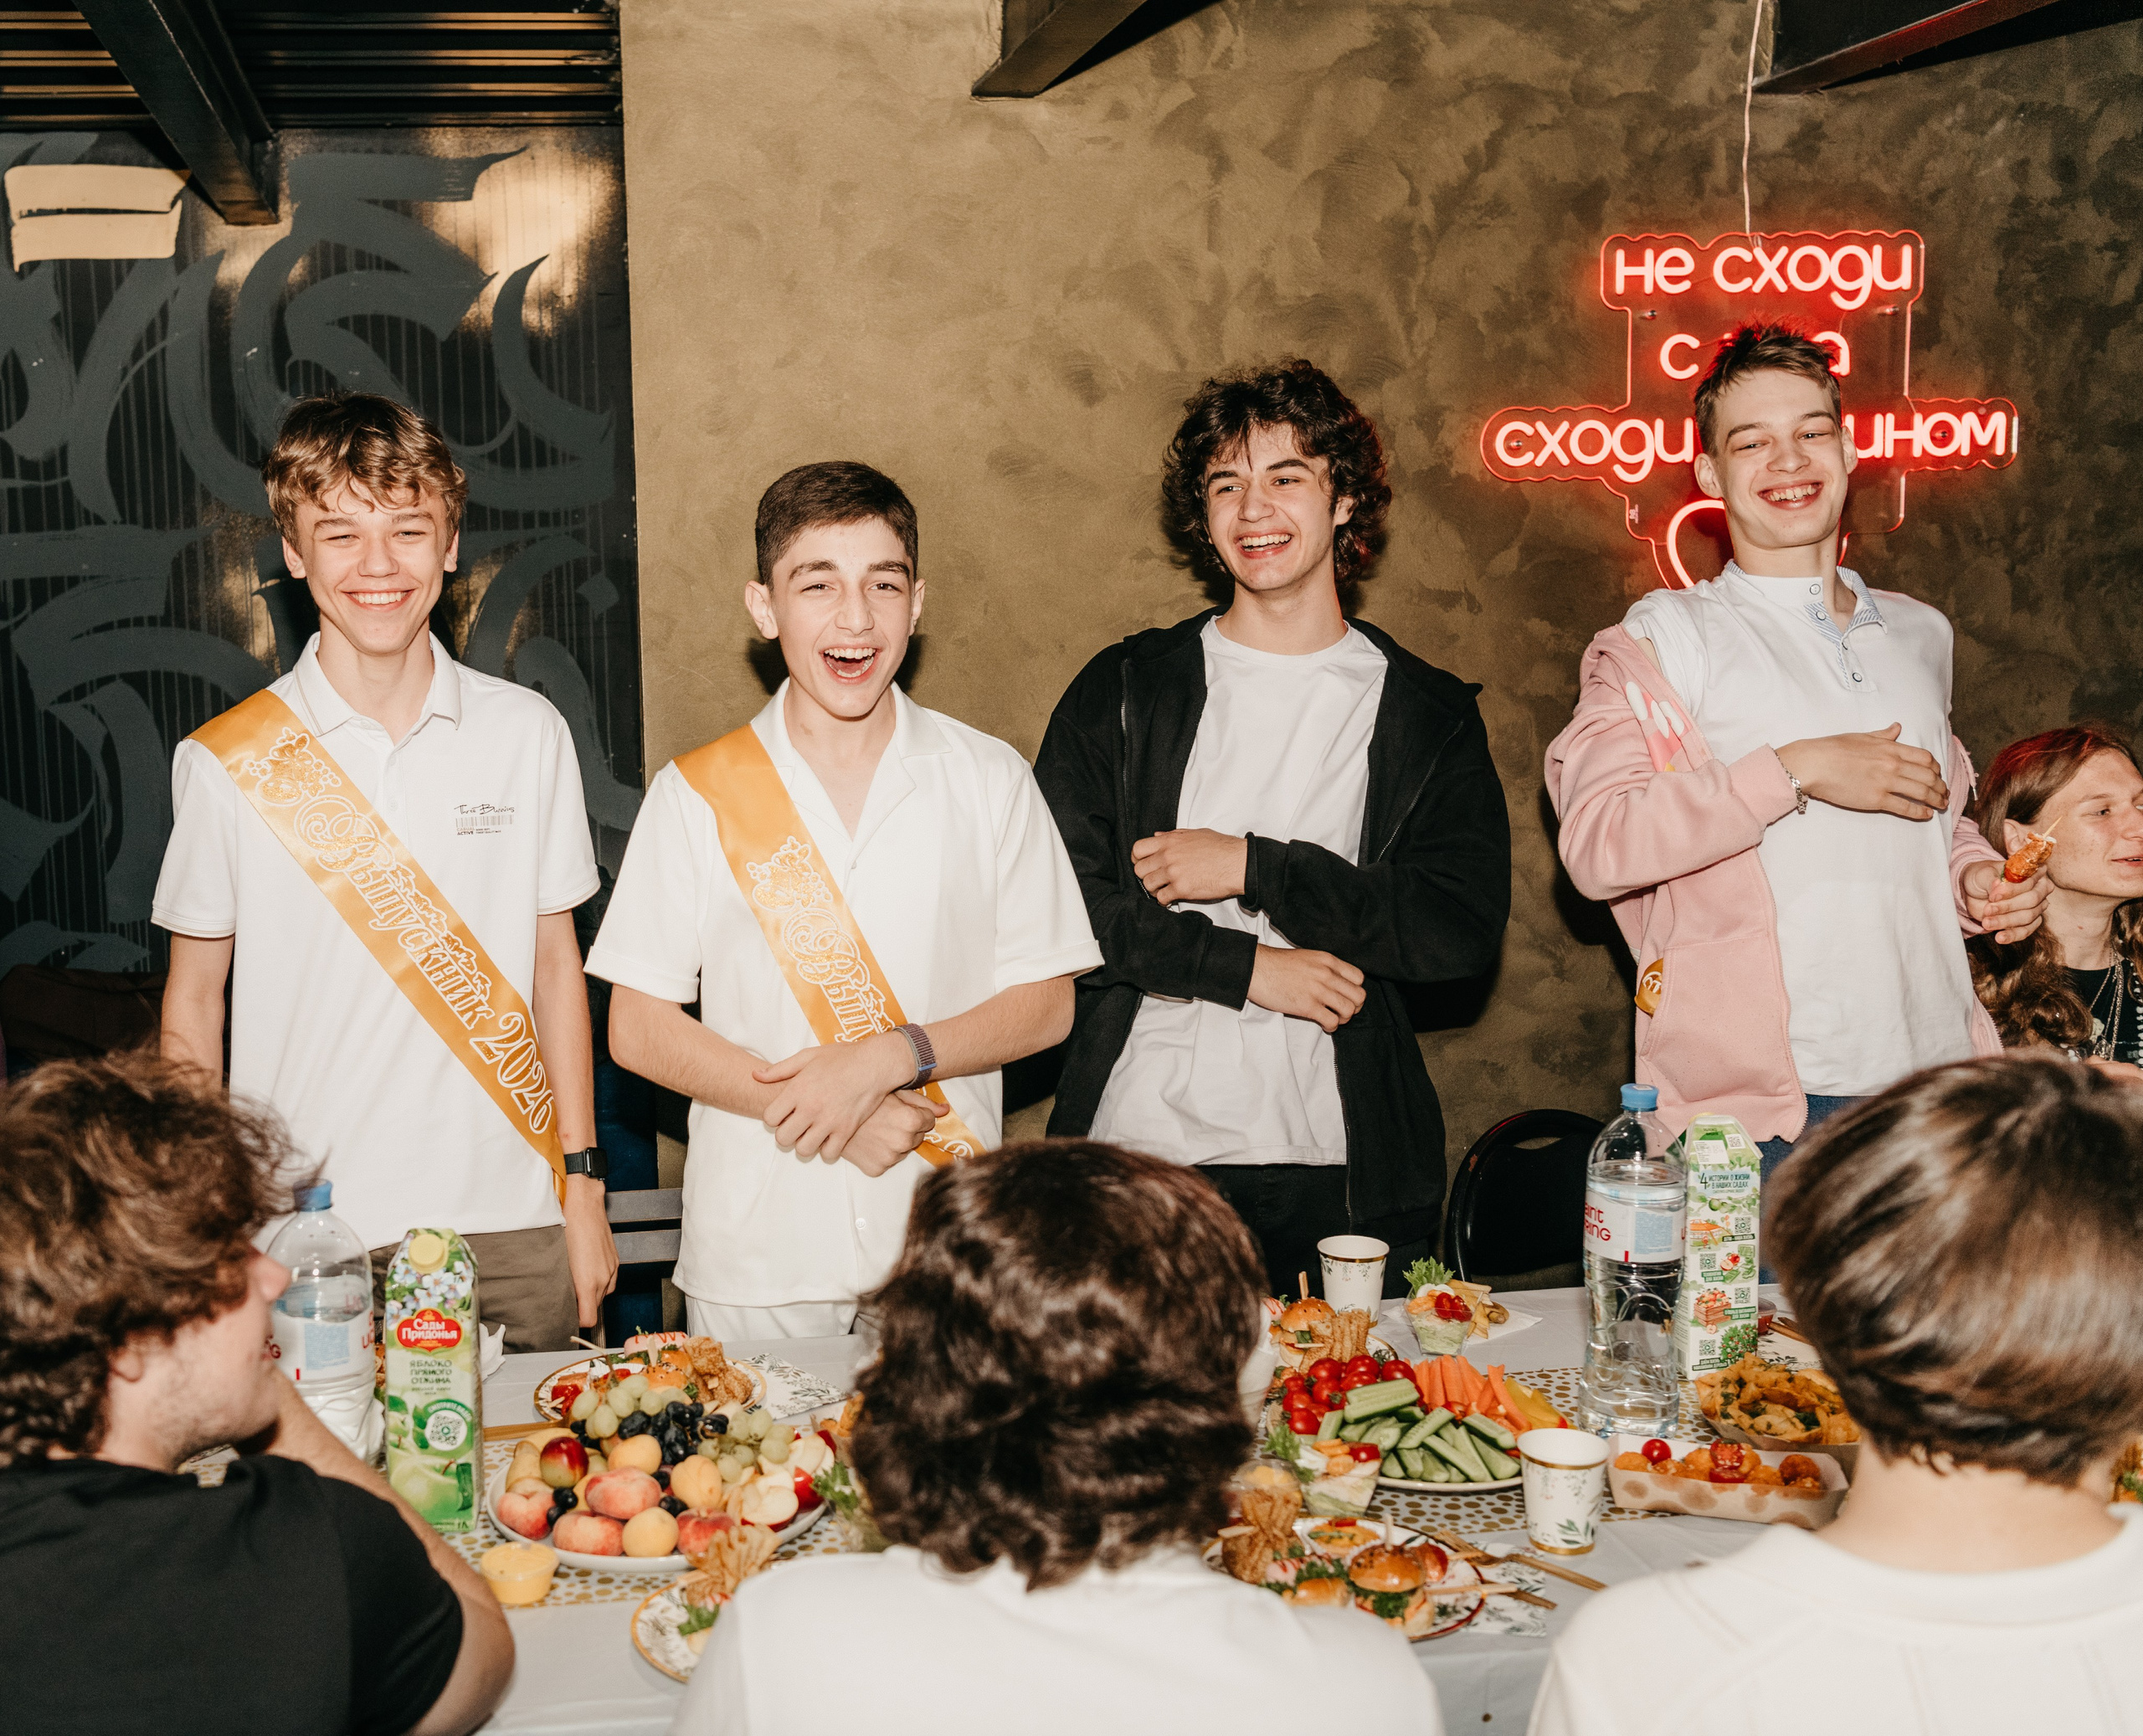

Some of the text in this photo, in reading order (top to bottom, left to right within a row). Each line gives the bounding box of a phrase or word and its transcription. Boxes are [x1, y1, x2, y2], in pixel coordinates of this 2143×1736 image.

[1615, 244, 1913, 310] не сходи
[1659, 333, 1700, 380] с
[1494, 411, 2007, 483] сходи ином
[469, 1011, 556, 1134] 2026
[1699, 1173, 1709, 1190] 4
[1584, 1201, 1604, 1224] aint
[413, 1318, 445, 1331] Сады
[402, 1328, 457, 1342] Придонья
[409, 1359, 452, 1368] ЯБЛОКО
[410, 1368, 452, 1376] ПРЯМОГО
